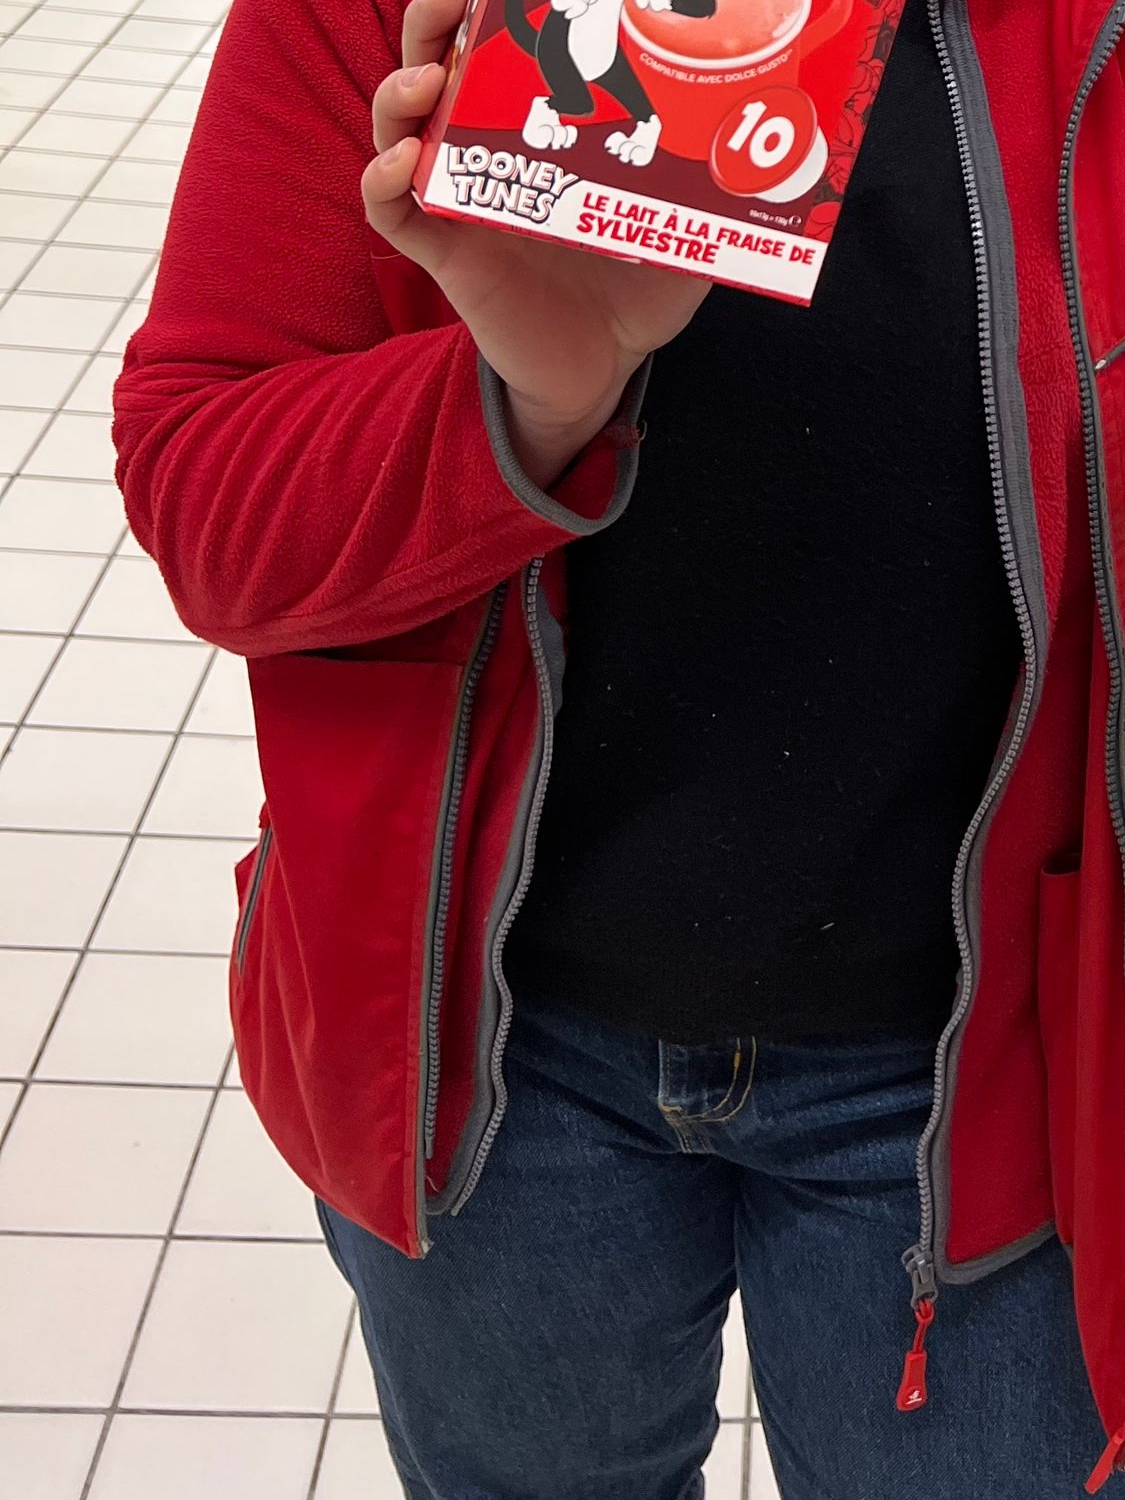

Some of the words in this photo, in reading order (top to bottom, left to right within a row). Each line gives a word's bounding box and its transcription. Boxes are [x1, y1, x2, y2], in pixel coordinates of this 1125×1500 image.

[639, 52, 696, 83] COMPATIBLE
[696, 73, 723, 84] AVEC
[724, 68, 757, 83] DOLCE
[726, 100, 796, 169] 10
[448, 144, 578, 197] LOONEY
[453, 174, 559, 224] TUNES
[576, 211, 720, 264] SYLVESTRE
[583, 192, 611, 211] LE
[613, 198, 660, 224] LAIT
[663, 208, 679, 231] À
[682, 217, 709, 239] LA
[716, 227, 784, 258] FRAISE
[788, 245, 817, 265] DE
